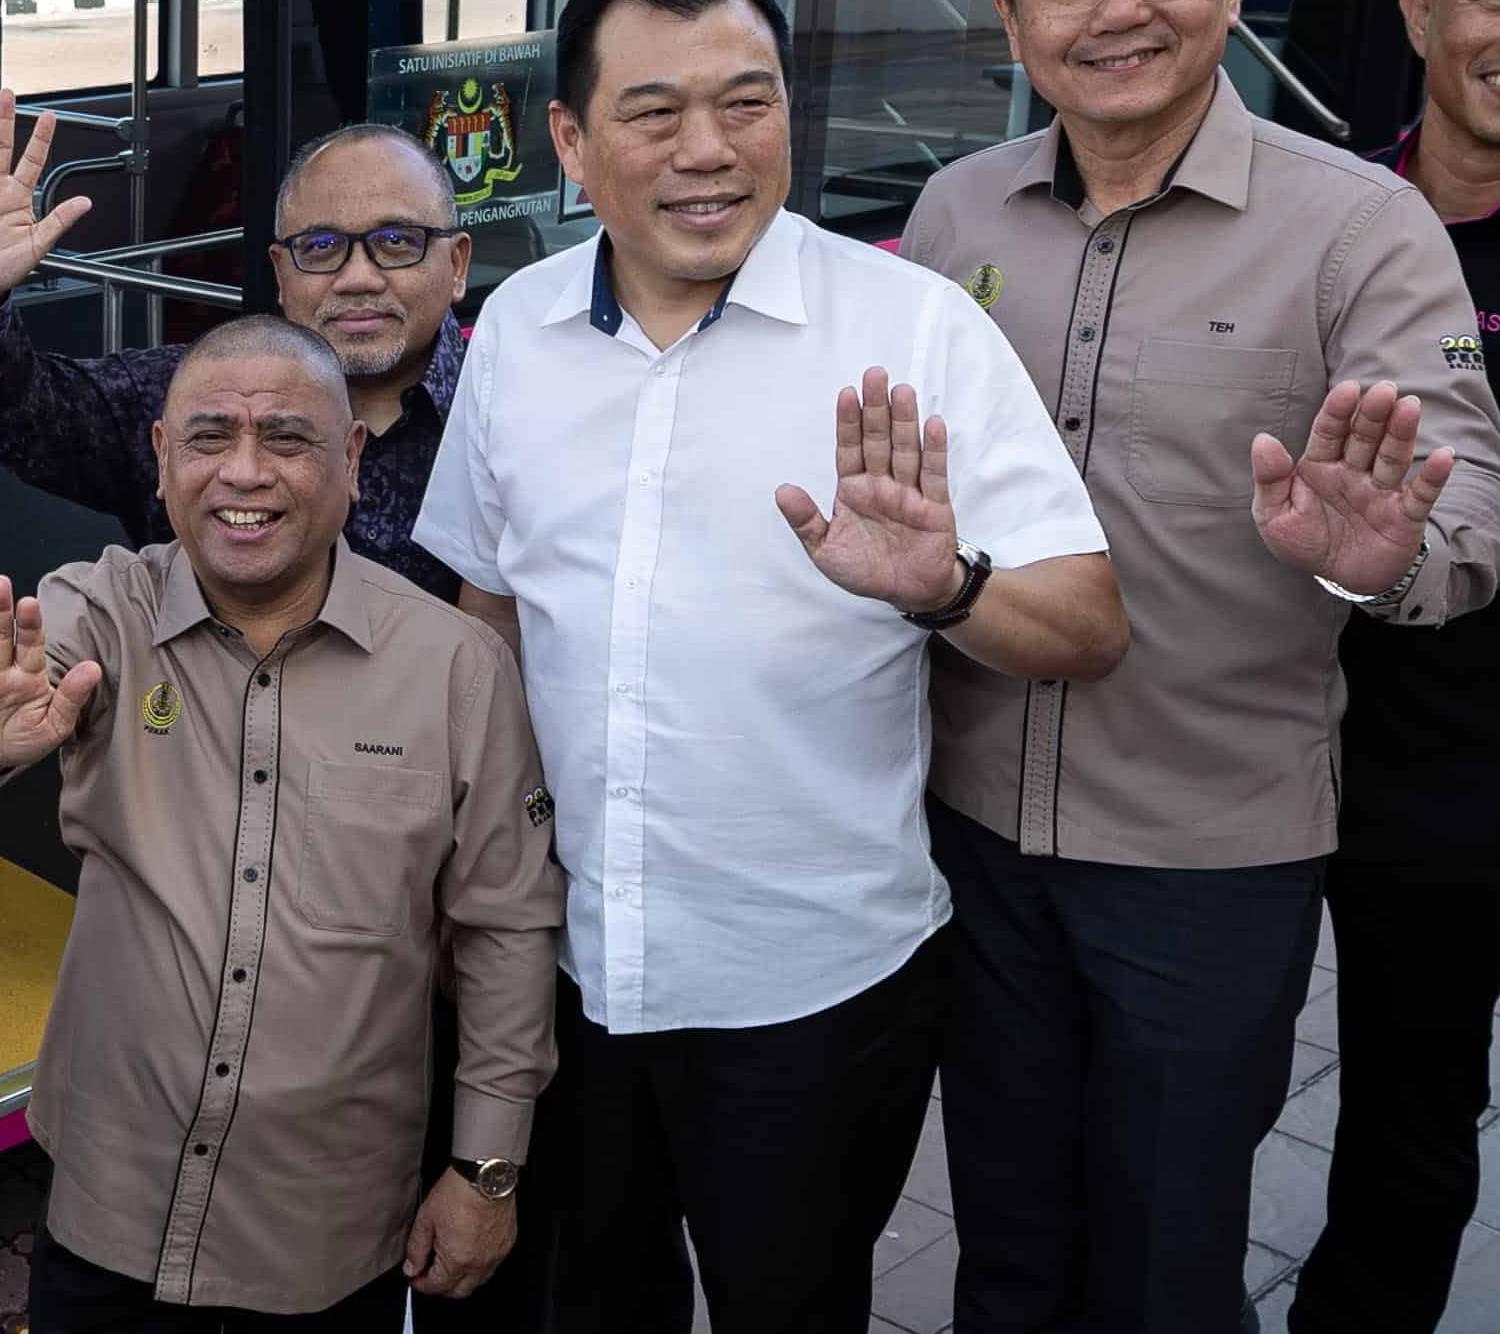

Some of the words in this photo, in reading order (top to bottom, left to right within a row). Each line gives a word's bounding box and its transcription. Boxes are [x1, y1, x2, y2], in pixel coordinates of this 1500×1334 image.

[399, 57, 431, 75] SATU
[432, 50, 482, 71] INISIATIF
[484, 48, 497, 64] DI
[500, 43, 541, 61] BAWAH
[460, 199, 551, 227] PENGANGKUTAN
[1208, 321, 1235, 333] TEH
[354, 742, 403, 756] SAARANI
